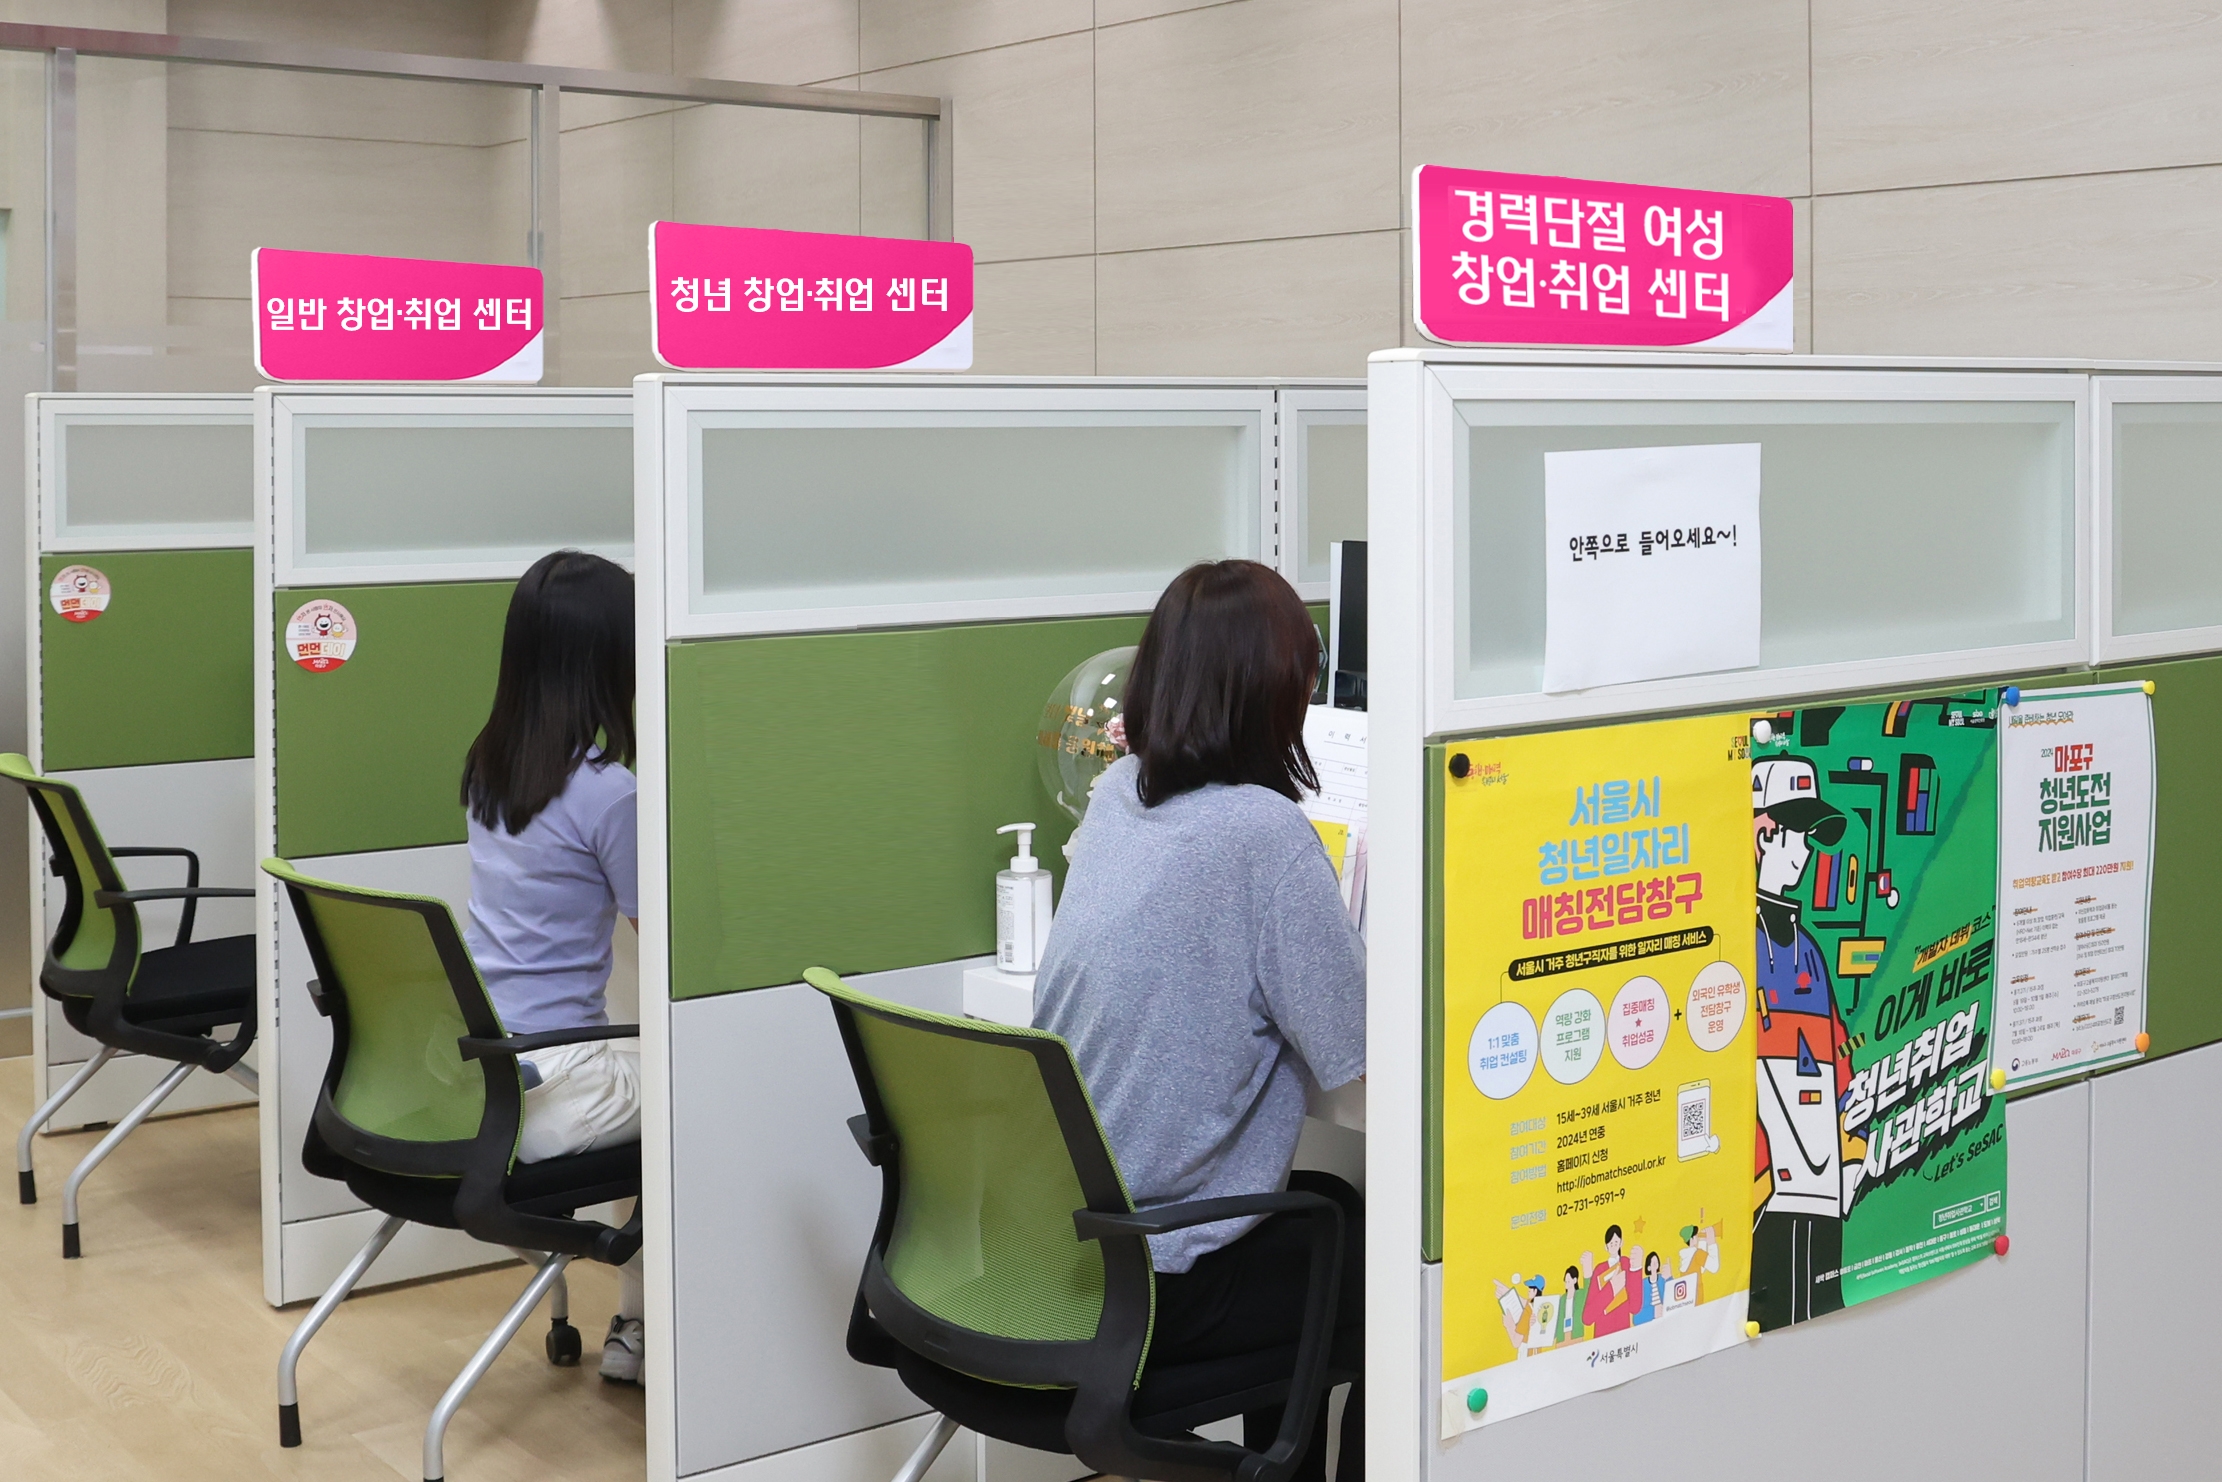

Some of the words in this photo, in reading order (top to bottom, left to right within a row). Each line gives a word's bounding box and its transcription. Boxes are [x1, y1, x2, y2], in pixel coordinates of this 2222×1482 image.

[1454, 188, 1627, 253] 경력단절
[1643, 205, 1724, 260] 여성
[670, 277, 731, 313] 청년
[744, 277, 873, 313] 창업·취업
[886, 278, 948, 312] 센터
[1451, 251, 1630, 315] 창업·취업
[1648, 267, 1730, 322] 센터
[267, 298, 327, 331] 일반
[337, 297, 461, 331] 창업·취업
[473, 298, 532, 331] 센터
[1569, 533, 1630, 562] 안쪽으로
[1638, 524, 1737, 556] 들어오세요~!
[2041, 748, 2053, 758] 2024
[2055, 743, 2094, 773] 마포구
[1569, 775, 1660, 827] 서울시
[2040, 772, 2111, 815] 청년도전
[2038, 810, 2112, 853] 지원사업
[1538, 822, 1690, 886] 청년일자리
[2062, 868, 2082, 882] 참여수당
[2083, 866, 2095, 878] 최대
[2096, 862, 2119, 876] 220만원
[1522, 871, 1703, 940] 매칭전담창구
[1950, 922, 1970, 947] 데뷔
[1515, 961, 1544, 977] 서울시
[1546, 957, 1564, 972] 거주
[1565, 944, 1618, 969] 청년구직자를
[1618, 942, 1637, 959] 위한
[1637, 938, 1663, 956] 일자리
[1663, 935, 1681, 951] 매칭
[1682, 931, 1707, 947] 서비스
[1622, 998, 1655, 1016] 집중매칭
[1692, 986, 1716, 1001] 외국인
[1717, 981, 1741, 997] 유학생
[1875, 970, 1934, 1041] 이게
[1936, 938, 1995, 1008] 바로
[1555, 1012, 1573, 1027] 역량
[1574, 1009, 1591, 1024] 강화
[1700, 1000, 1732, 1019] 전담창구
[1708, 1019, 1724, 1034] 운영
[1488, 1036, 1500, 1050] 1:1
[1501, 1032, 1519, 1048] 맞춤
[1556, 1027, 1590, 1046] 프로그램
[1564, 1047, 1582, 1062] 지원
[1622, 1029, 1654, 1048] 취업성공
[1480, 1055, 1498, 1071] 취업
[1500, 1049, 1527, 1067] 컨설팅
[1843, 1000, 1980, 1133] 청년취업
[1510, 1116, 1547, 1137] 참여대상
[1556, 1103, 1600, 1125] 15세~39세
[1601, 1097, 1626, 1115] 서울시
[1628, 1093, 1643, 1108] 거주
[1645, 1089, 1661, 1104] 청년
[1853, 1059, 1988, 1191] 사관학교
[1510, 1140, 1547, 1161] 참여기간
[1556, 1132, 1588, 1149] 2024년
[1589, 1125, 1606, 1142] 연중
[1933, 1152, 1964, 1183] Let's
[1967, 1123, 2004, 1163] SeSAC
[1510, 1164, 1547, 1185] 참여방법
[1556, 1152, 1590, 1174] 홈페이지
[1592, 1148, 1609, 1164] 신청
[1556, 1155, 1667, 1194] http://jobmatchseoul.or.kr
[1510, 1208, 1547, 1230] 문의전화
[1556, 1188, 1626, 1217] 02-731-9591~9
[1600, 1342, 1639, 1364] 서울특별시
